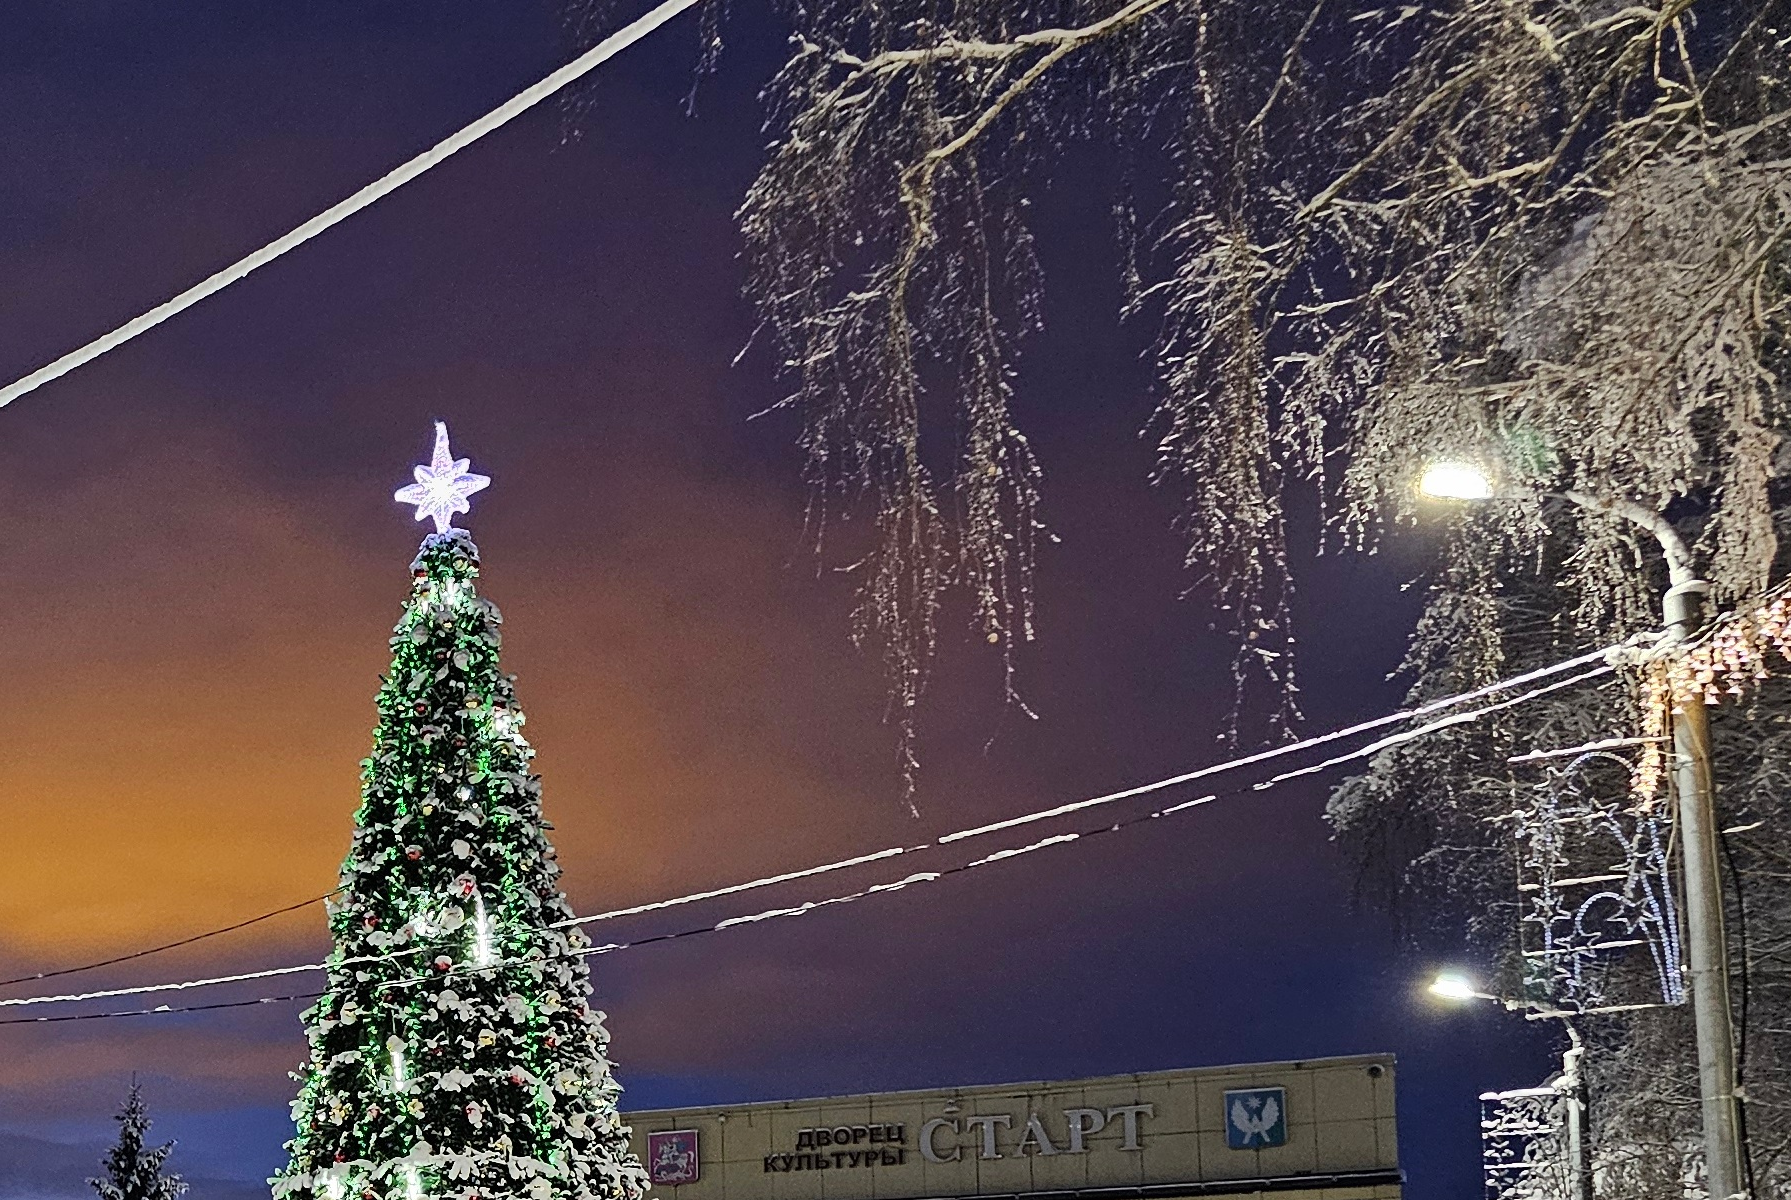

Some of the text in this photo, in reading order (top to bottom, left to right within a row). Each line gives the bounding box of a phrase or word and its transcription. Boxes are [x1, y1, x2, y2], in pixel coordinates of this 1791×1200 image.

[795, 1122, 907, 1151] ДВОРЕЦ
[918, 1104, 1154, 1163] СТАРТ
[762, 1148, 907, 1174] КУЛЬТУРЫ
